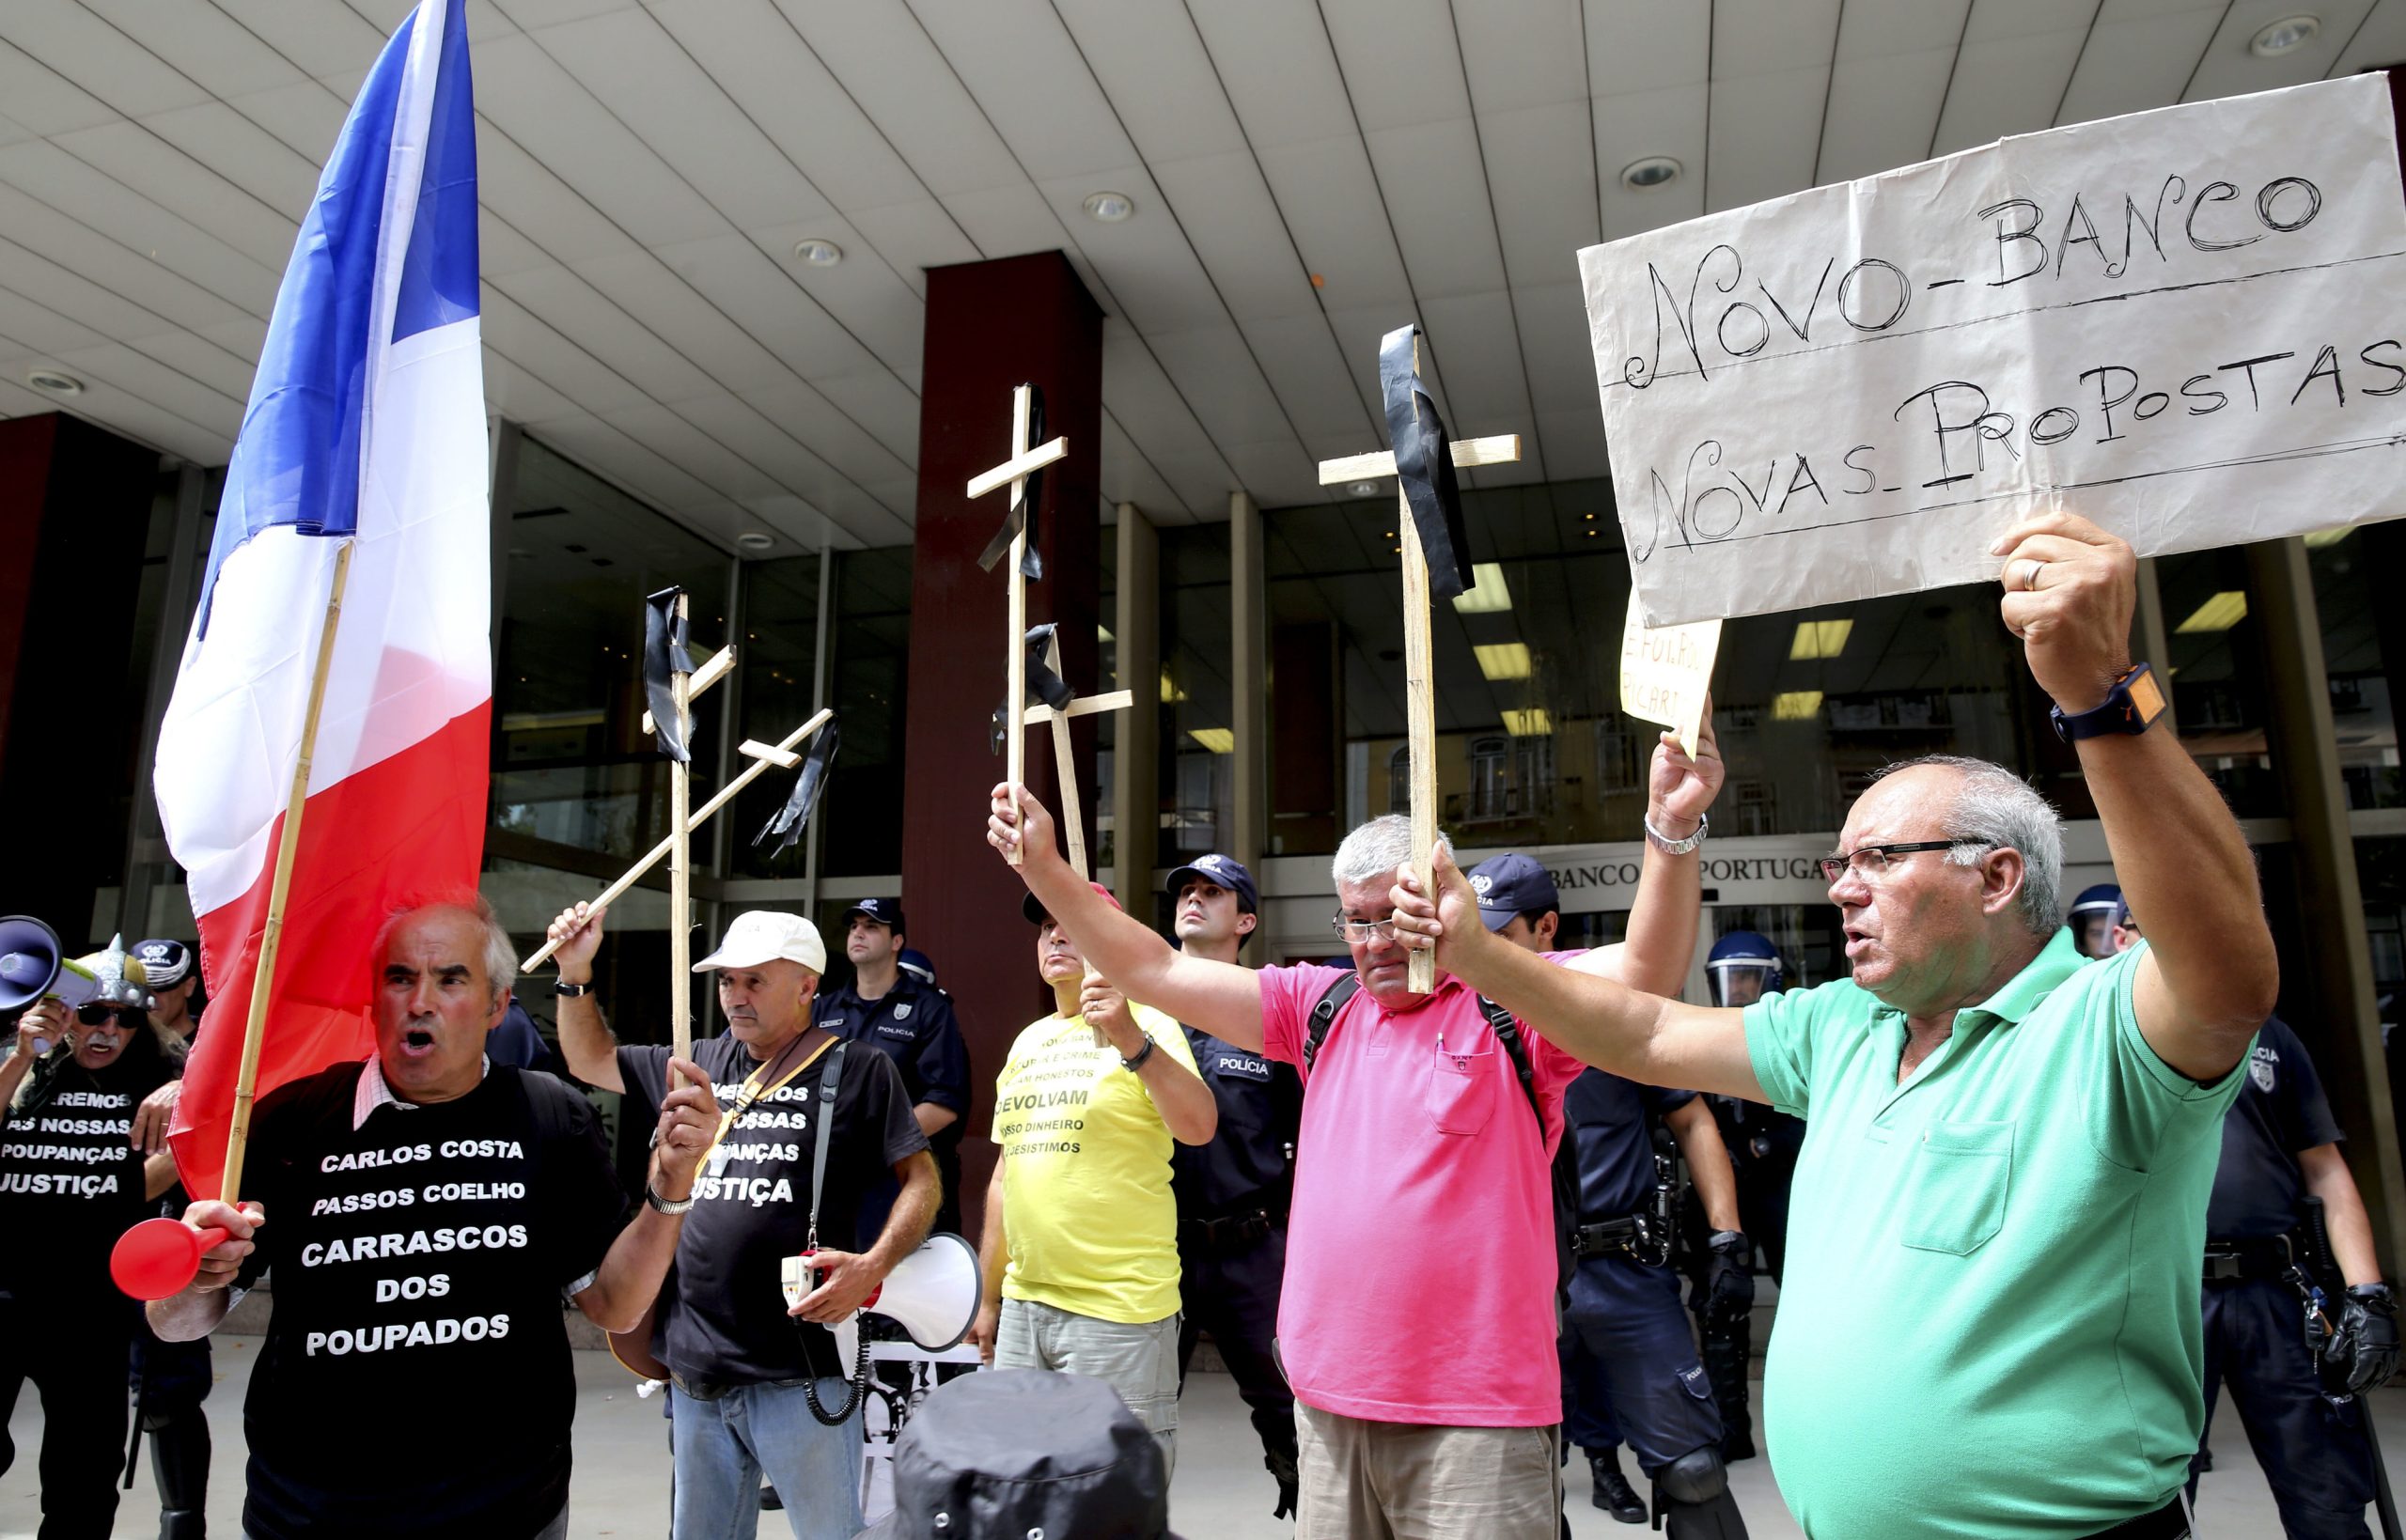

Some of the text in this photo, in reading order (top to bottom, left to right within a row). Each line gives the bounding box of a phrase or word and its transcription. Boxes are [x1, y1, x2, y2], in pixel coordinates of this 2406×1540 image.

[1551, 858, 1826, 890] BANCO PORTUGA
[1219, 1057, 1269, 1076] POLÍCIA
[52, 1092, 132, 1110] REMOS
[40, 1118, 132, 1135] NOSSAS
[732, 1112, 807, 1130] OSSAS
[1025, 1119, 1085, 1132] DINHEIRO
[1, 1143, 128, 1165] POUPANÇAS
[320, 1140, 524, 1173] CARLOS COSTA
[0, 1173, 118, 1199] JUSTIÇA
[311, 1182, 526, 1217] PASSOS COELHO
[691, 1176, 794, 1208] USTIÇA
[301, 1224, 528, 1268] CARRASCOS
[376, 1273, 450, 1303] DOS
[306, 1314, 510, 1357] POUPADOS
